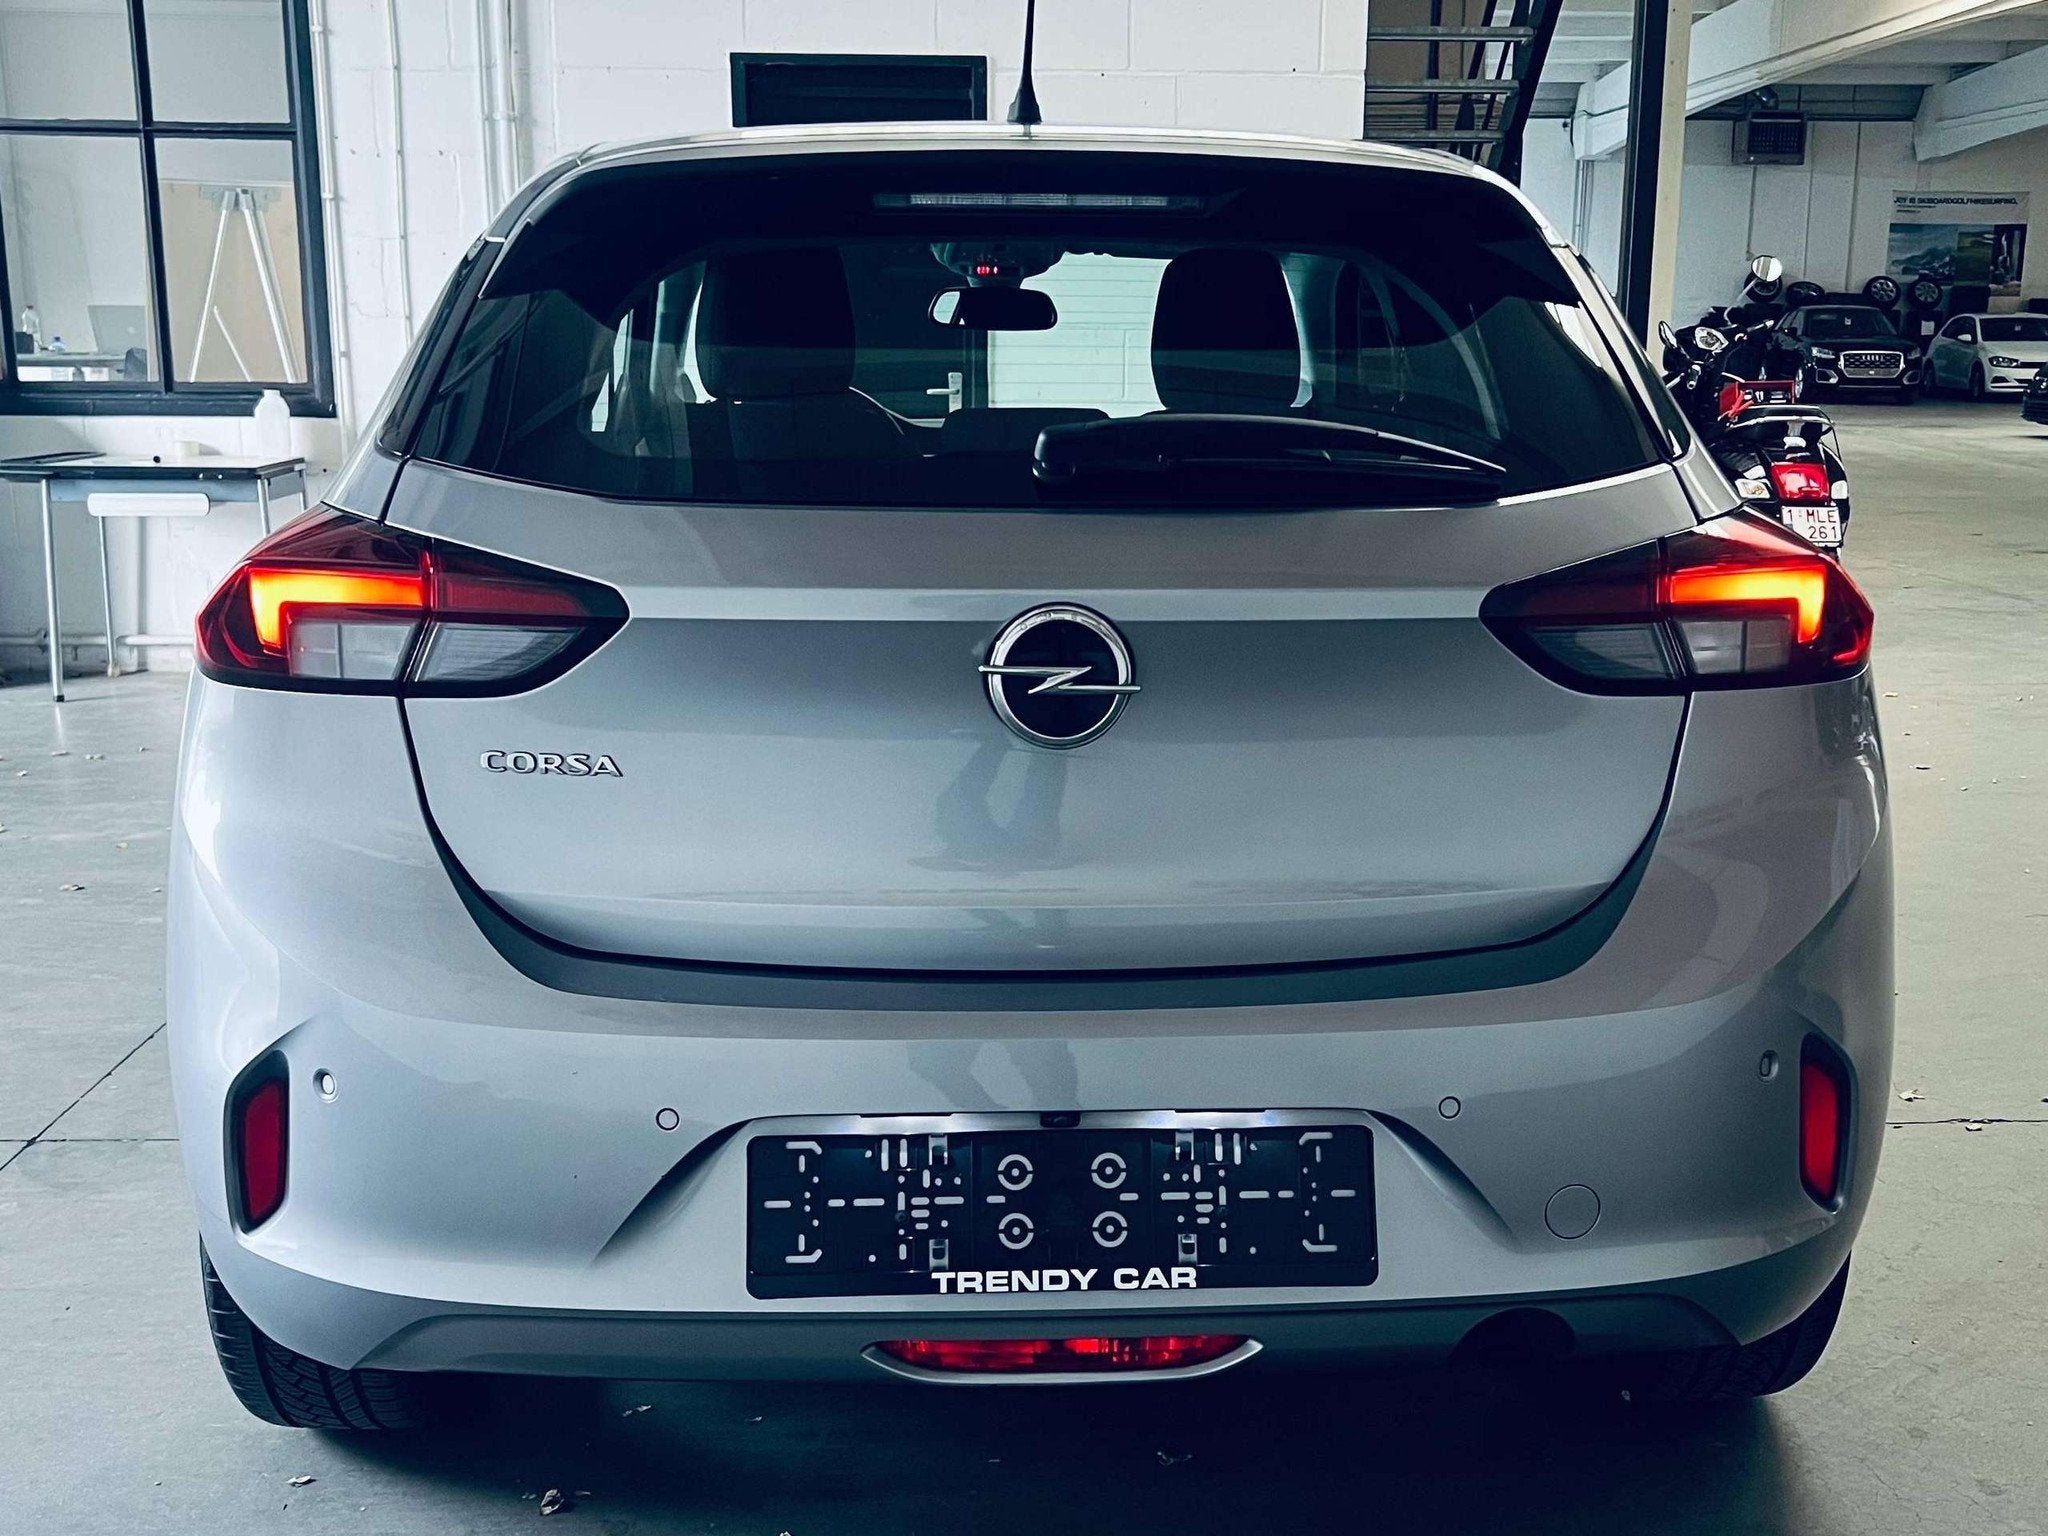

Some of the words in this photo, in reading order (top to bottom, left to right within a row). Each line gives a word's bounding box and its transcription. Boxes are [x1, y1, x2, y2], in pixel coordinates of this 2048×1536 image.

[1787, 509, 1793, 522] 1
[1806, 509, 1837, 523] MLE
[1808, 526, 1837, 539] 261
[480, 750, 624, 778] CORSA
[931, 1268, 1098, 1294] TRENDY
[1113, 1266, 1197, 1290] CAR
